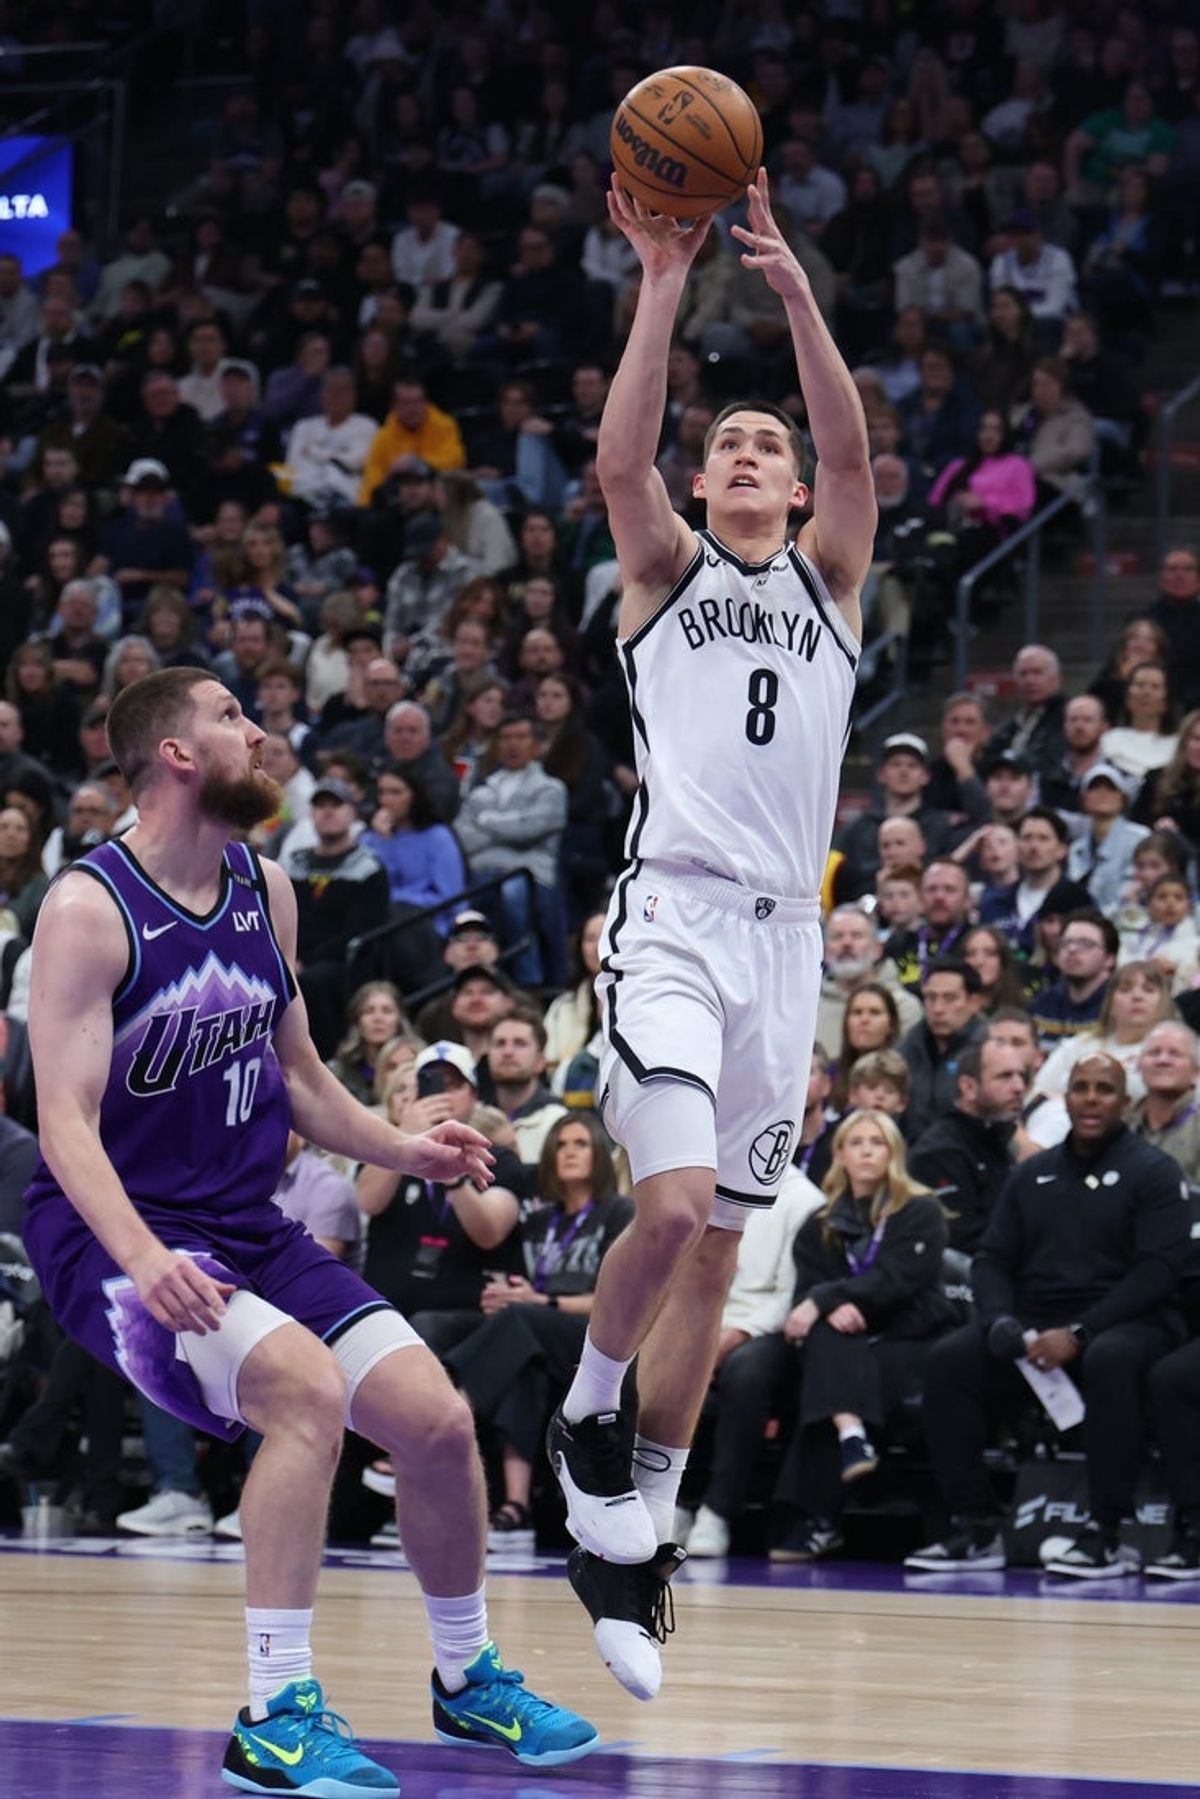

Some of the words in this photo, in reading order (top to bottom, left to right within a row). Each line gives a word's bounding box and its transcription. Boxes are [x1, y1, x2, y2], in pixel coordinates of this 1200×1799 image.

[616, 113, 688, 188] Wilson
[678, 598, 822, 663] BROOKLYN
[745, 668, 779, 746] 8
[232, 911, 260, 931] LVT
[126, 996, 278, 1098] UTAH
[223, 1057, 262, 1127] 10
